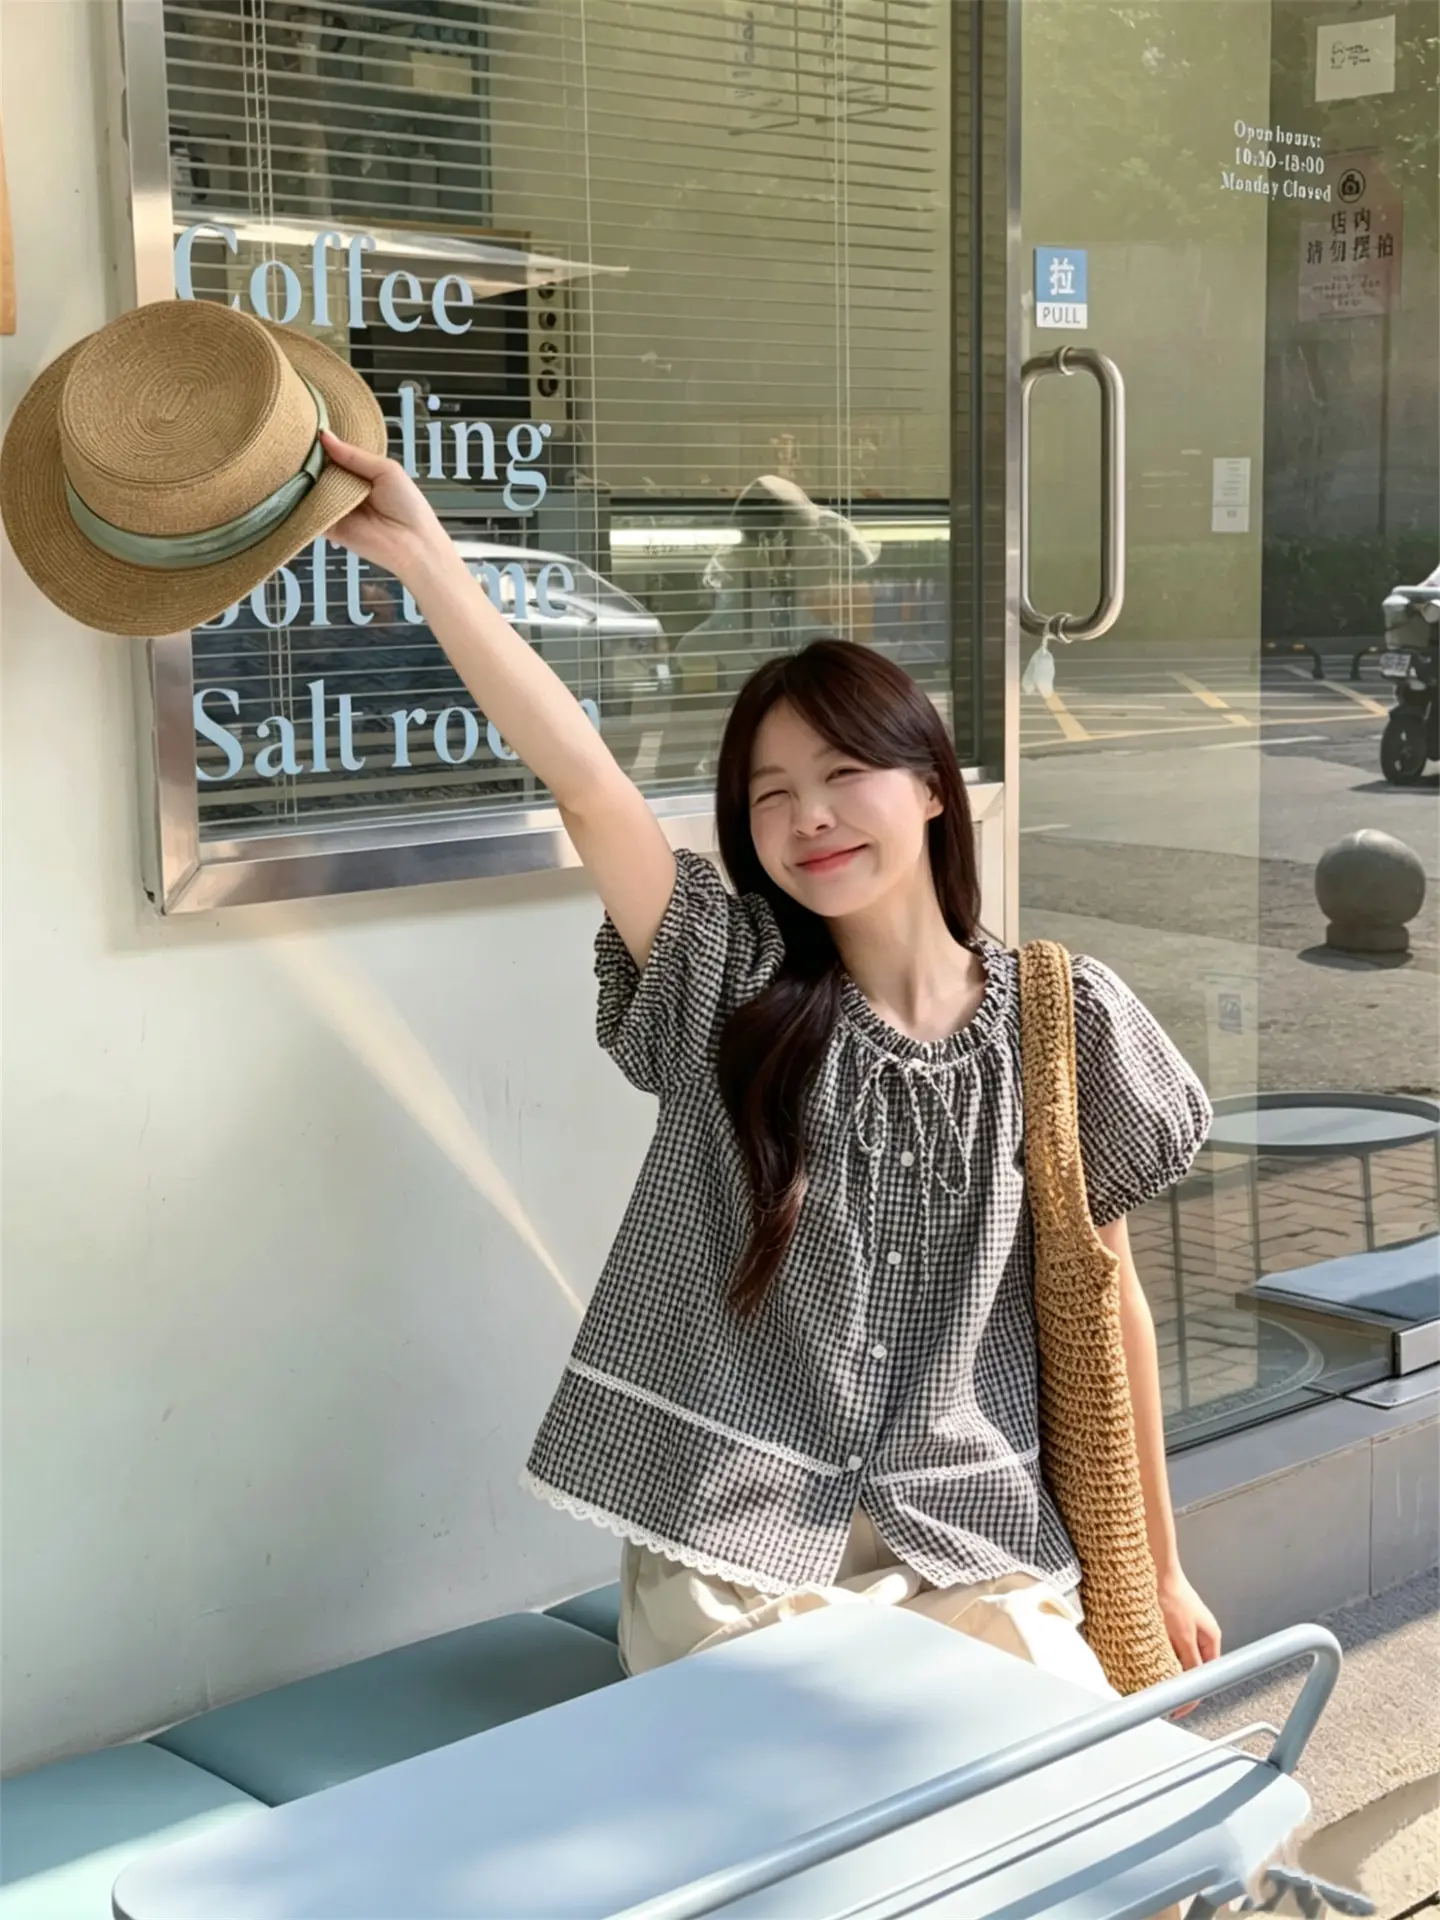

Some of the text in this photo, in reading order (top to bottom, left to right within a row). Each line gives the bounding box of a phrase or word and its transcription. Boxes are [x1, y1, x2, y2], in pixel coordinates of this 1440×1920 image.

[1220, 171, 1279, 201] Monday
[174, 222, 474, 335] Coffee
[1049, 257, 1076, 296] 拉
[1042, 306, 1081, 324] PULL
[199, 535, 375, 629] oft
[193, 679, 366, 781] Salt
